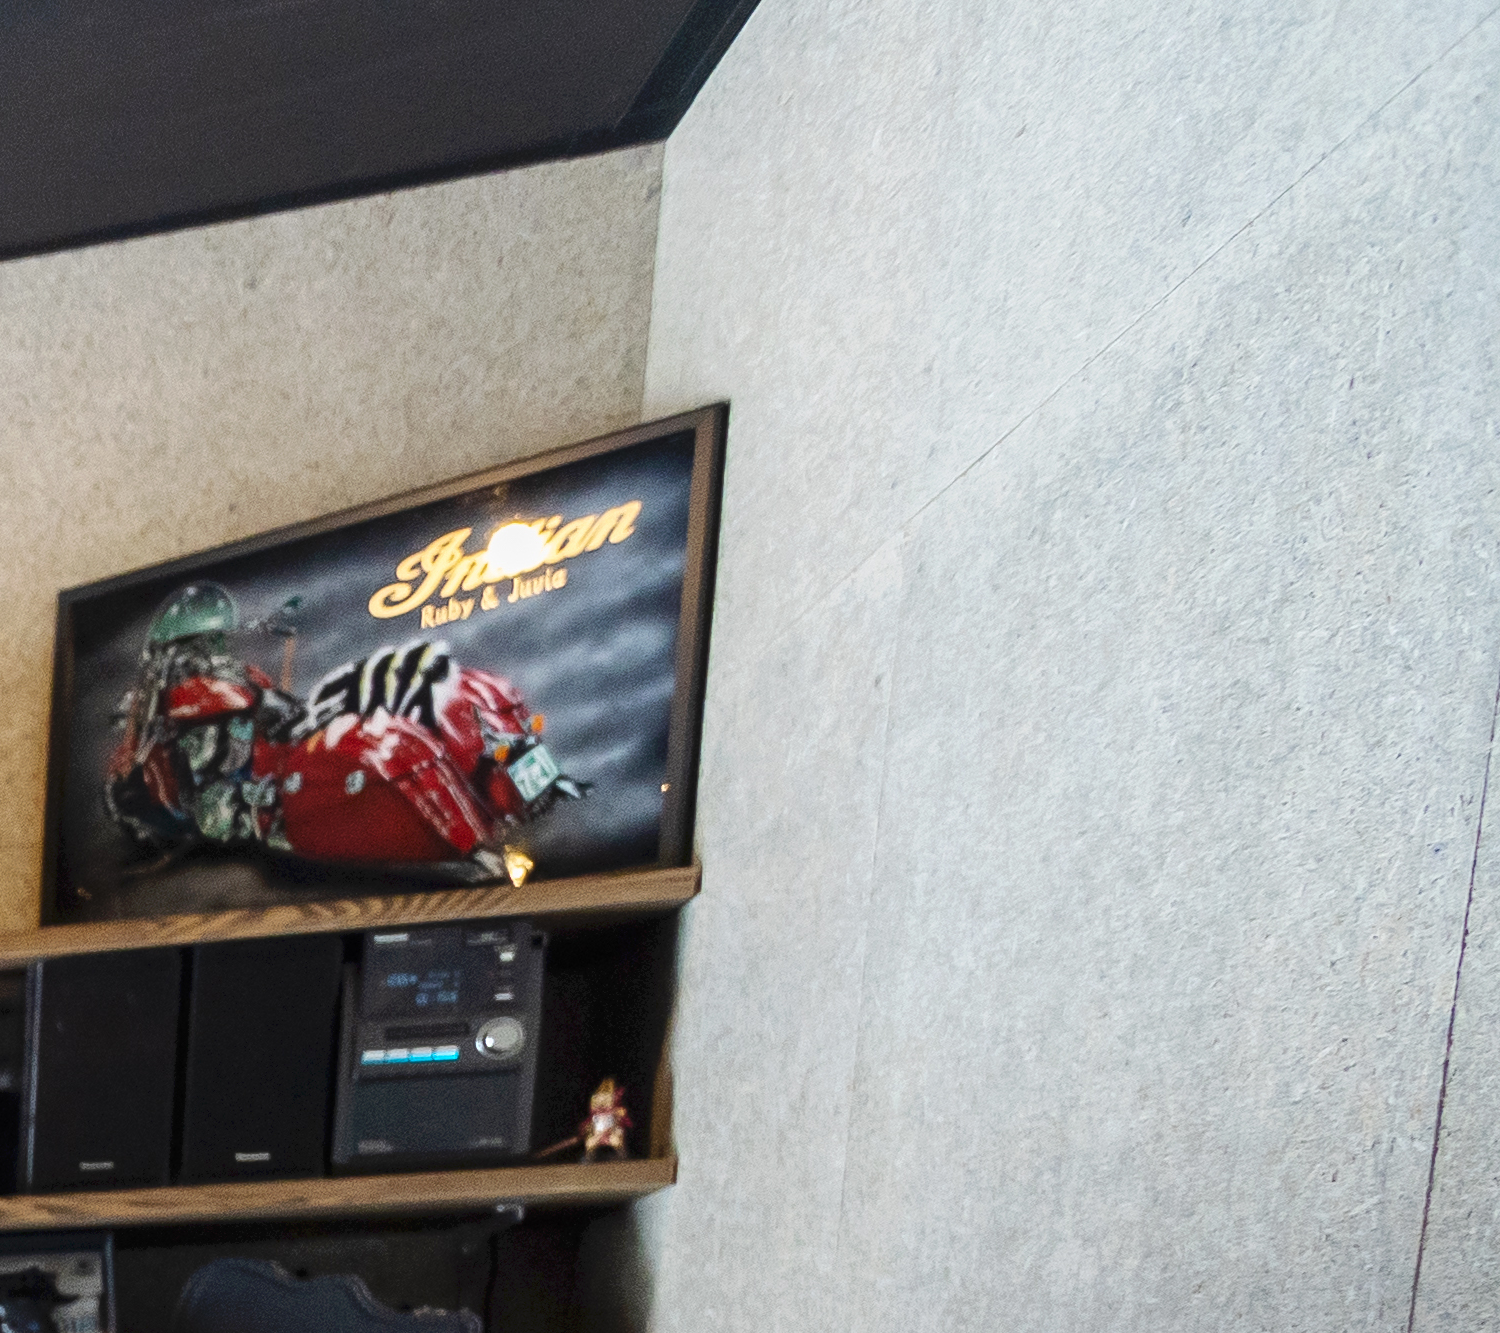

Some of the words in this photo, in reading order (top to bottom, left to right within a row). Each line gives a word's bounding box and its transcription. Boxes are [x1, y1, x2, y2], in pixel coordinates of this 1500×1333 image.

[368, 500, 642, 618] Inian
[420, 598, 475, 628] Ruby
[481, 586, 500, 611] &
